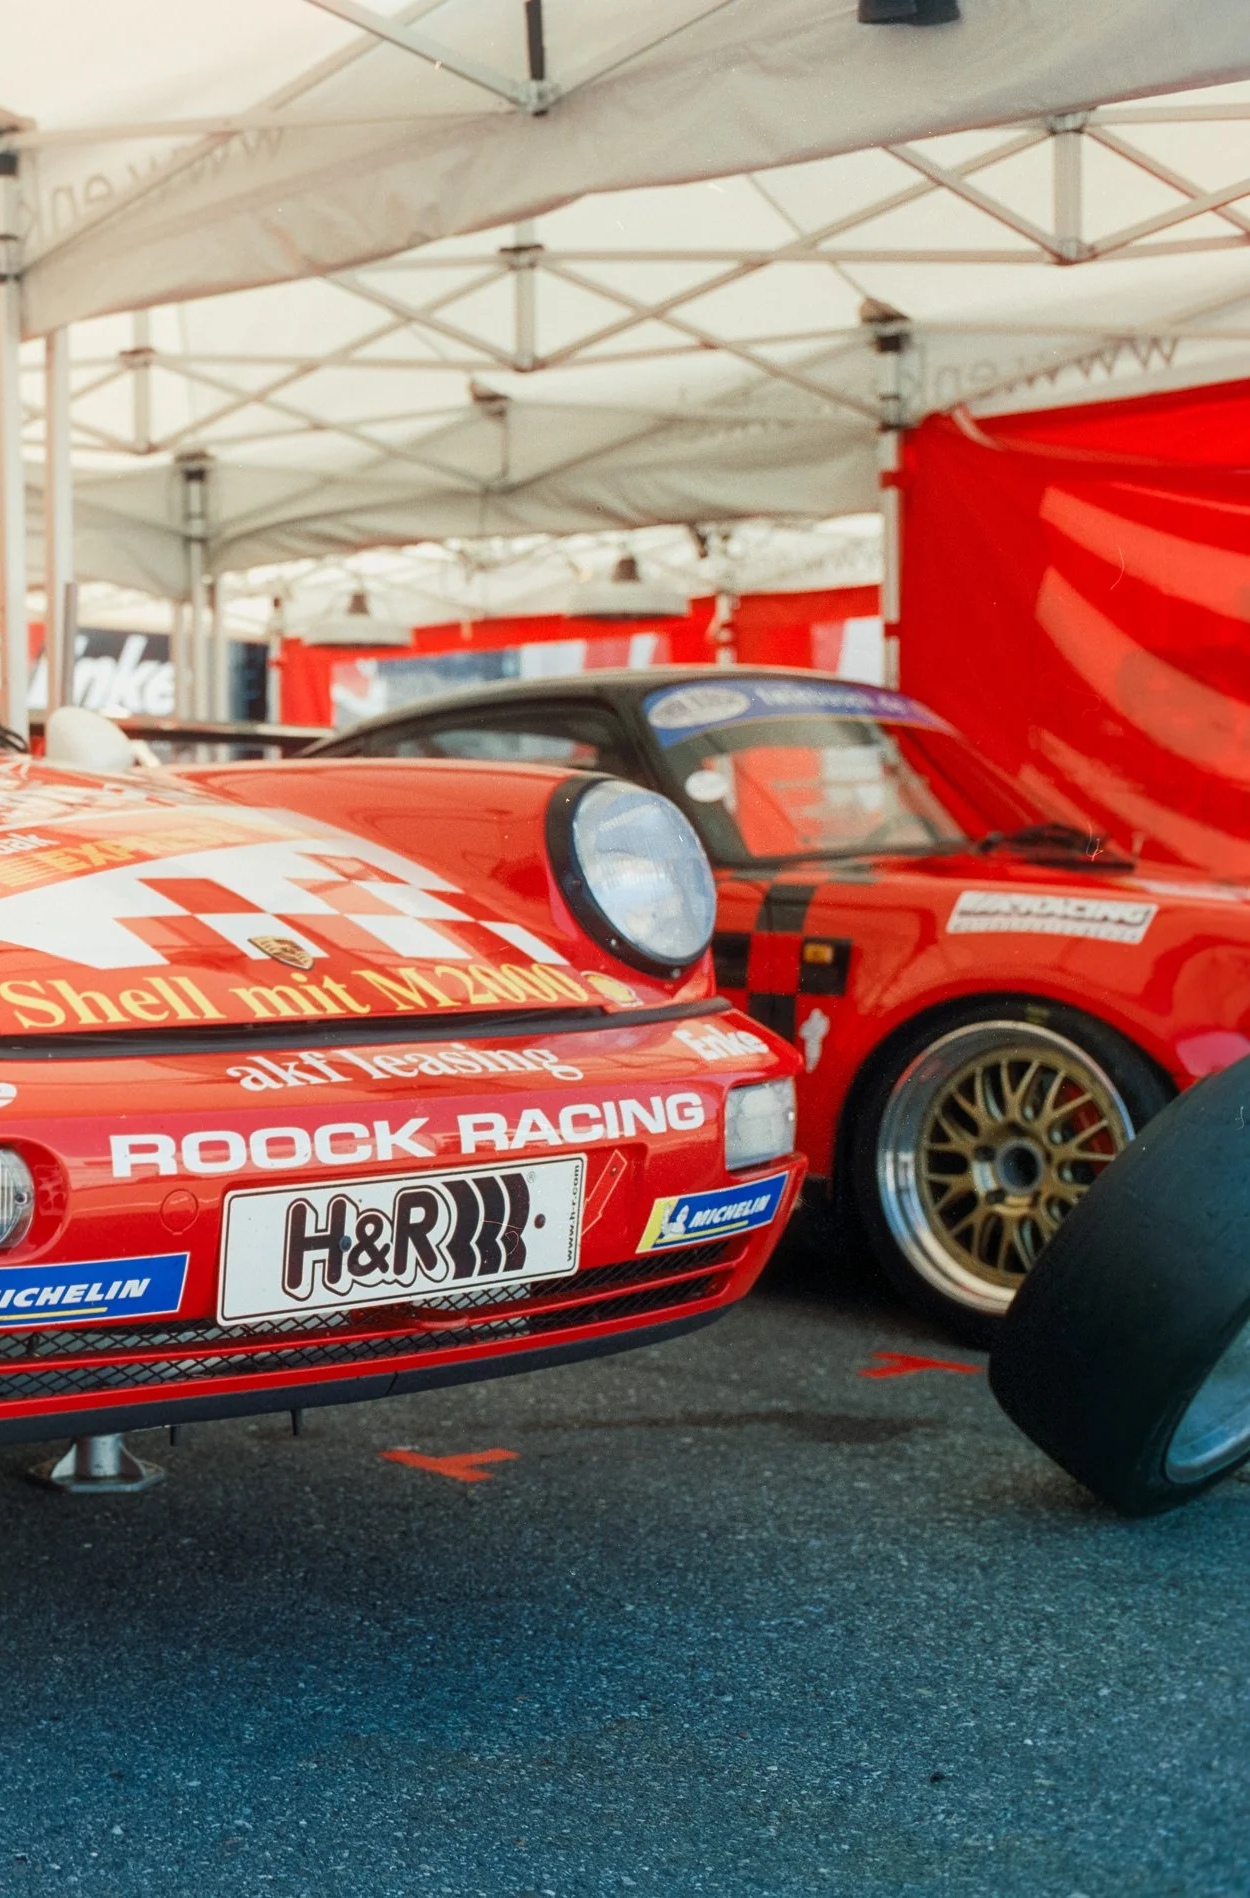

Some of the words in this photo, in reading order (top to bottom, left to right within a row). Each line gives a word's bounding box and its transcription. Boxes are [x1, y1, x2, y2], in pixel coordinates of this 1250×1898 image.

[231, 972, 370, 1019] mit
[672, 1024, 770, 1061] Enke
[226, 1050, 351, 1092] akf
[342, 1044, 584, 1081] leasing
[109, 1117, 437, 1178] ROOCK
[455, 1092, 706, 1154] RACING
[565, 1164, 580, 1263] www.h-r.com
[688, 1194, 772, 1229] MICHELIN
[282, 1185, 452, 1301] H&R
